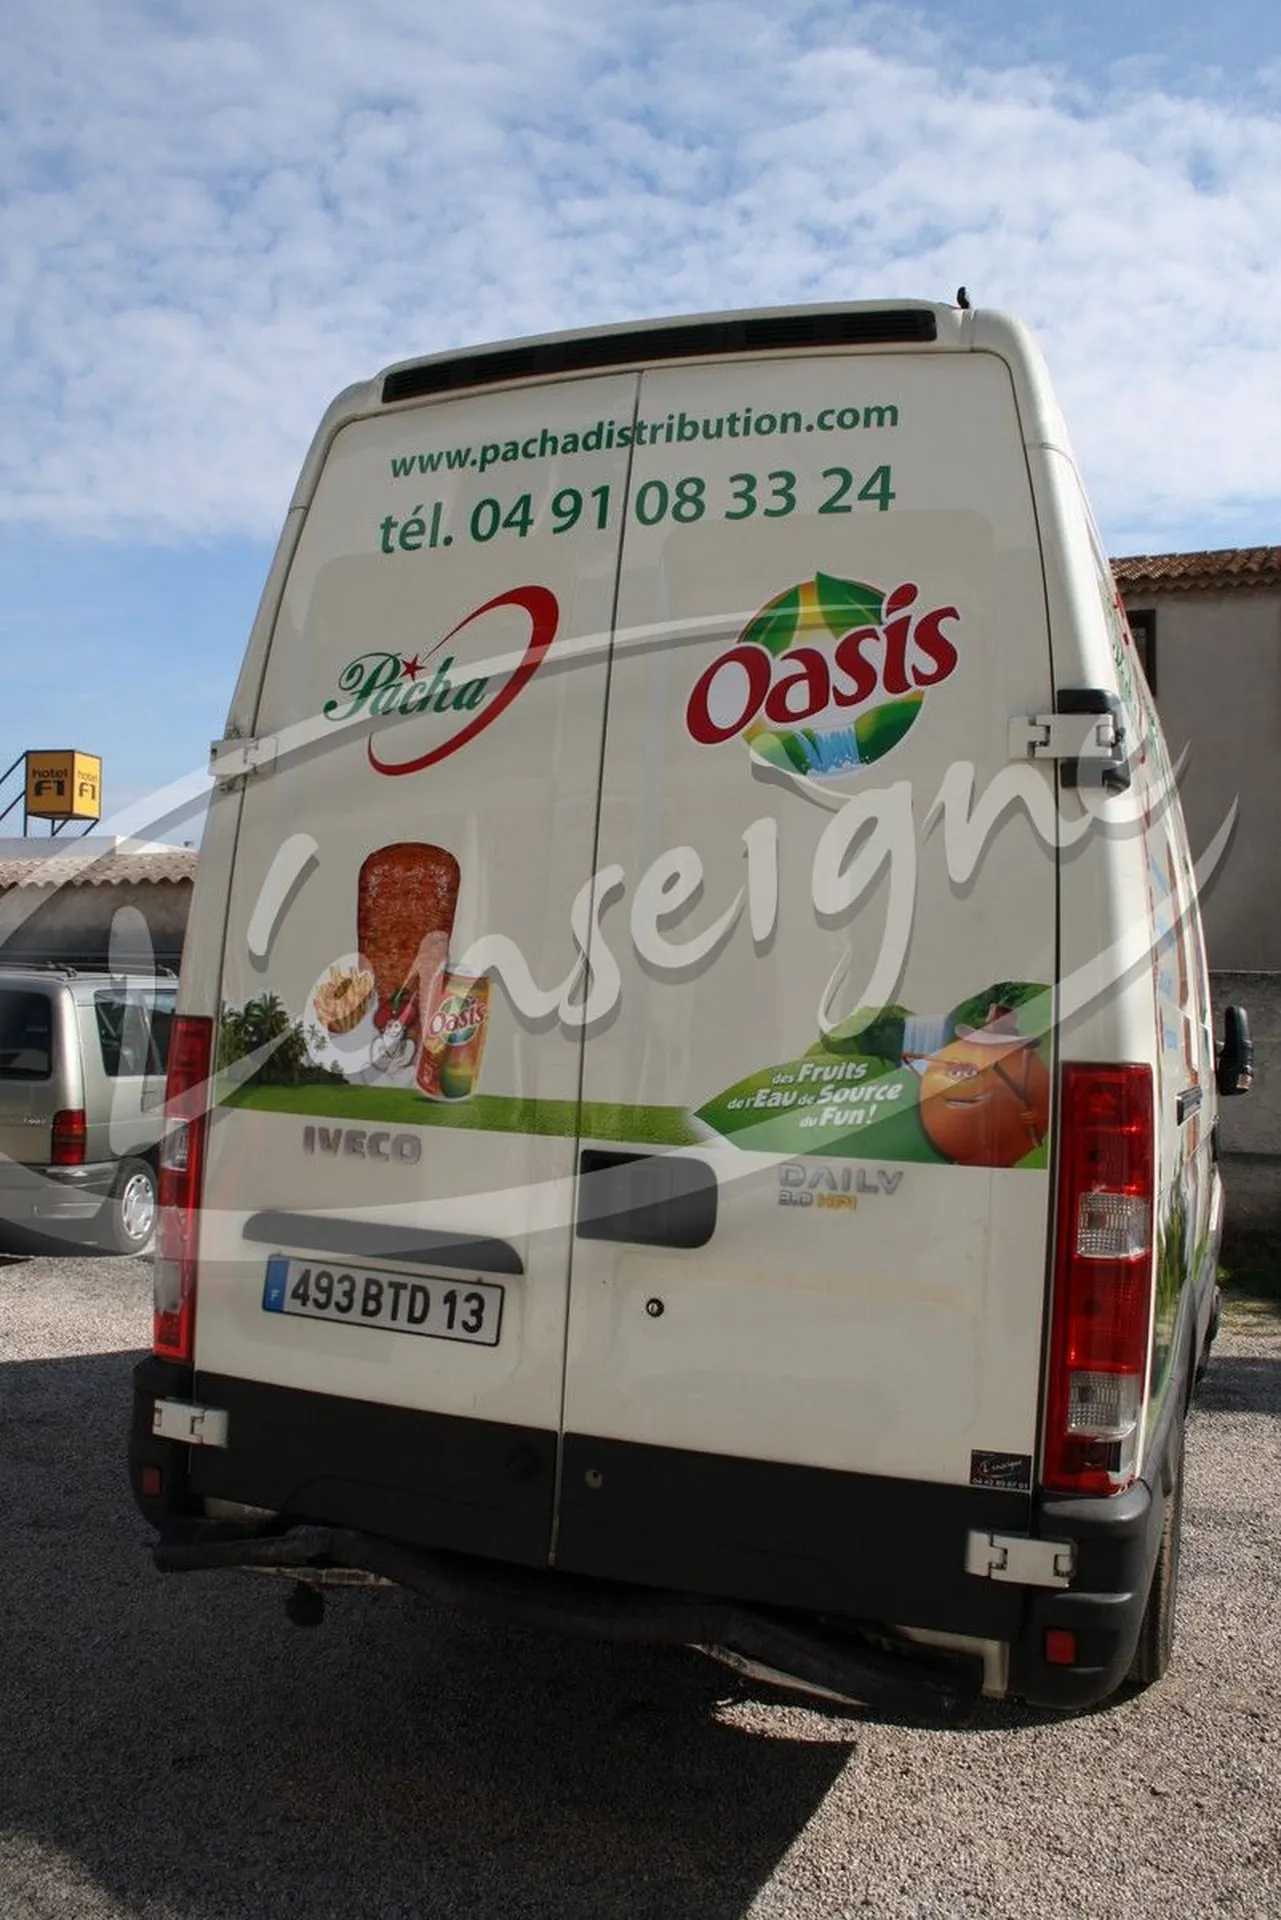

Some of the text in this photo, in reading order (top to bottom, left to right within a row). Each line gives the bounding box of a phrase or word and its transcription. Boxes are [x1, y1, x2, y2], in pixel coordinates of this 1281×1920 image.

[390, 403, 899, 478] www.pachadistribution.com
[379, 464, 897, 554] tél. 04 91 08 33 24
[686, 582, 960, 744] Oasis
[323, 651, 487, 721] Pacha
[32, 768, 67, 778] hotel
[35, 780, 65, 796] F1
[77, 770, 97, 780] hotel
[79, 782, 96, 800] F1
[429, 996, 488, 1036] Oasis
[772, 1062, 868, 1084] des Fruits
[817, 1083, 902, 1105] Source
[799, 1104, 877, 1127] du Fun!
[302, 1126, 423, 1166] IVECO
[779, 1162, 904, 1196] DAILY
[442, 1288, 486, 1334] 13
